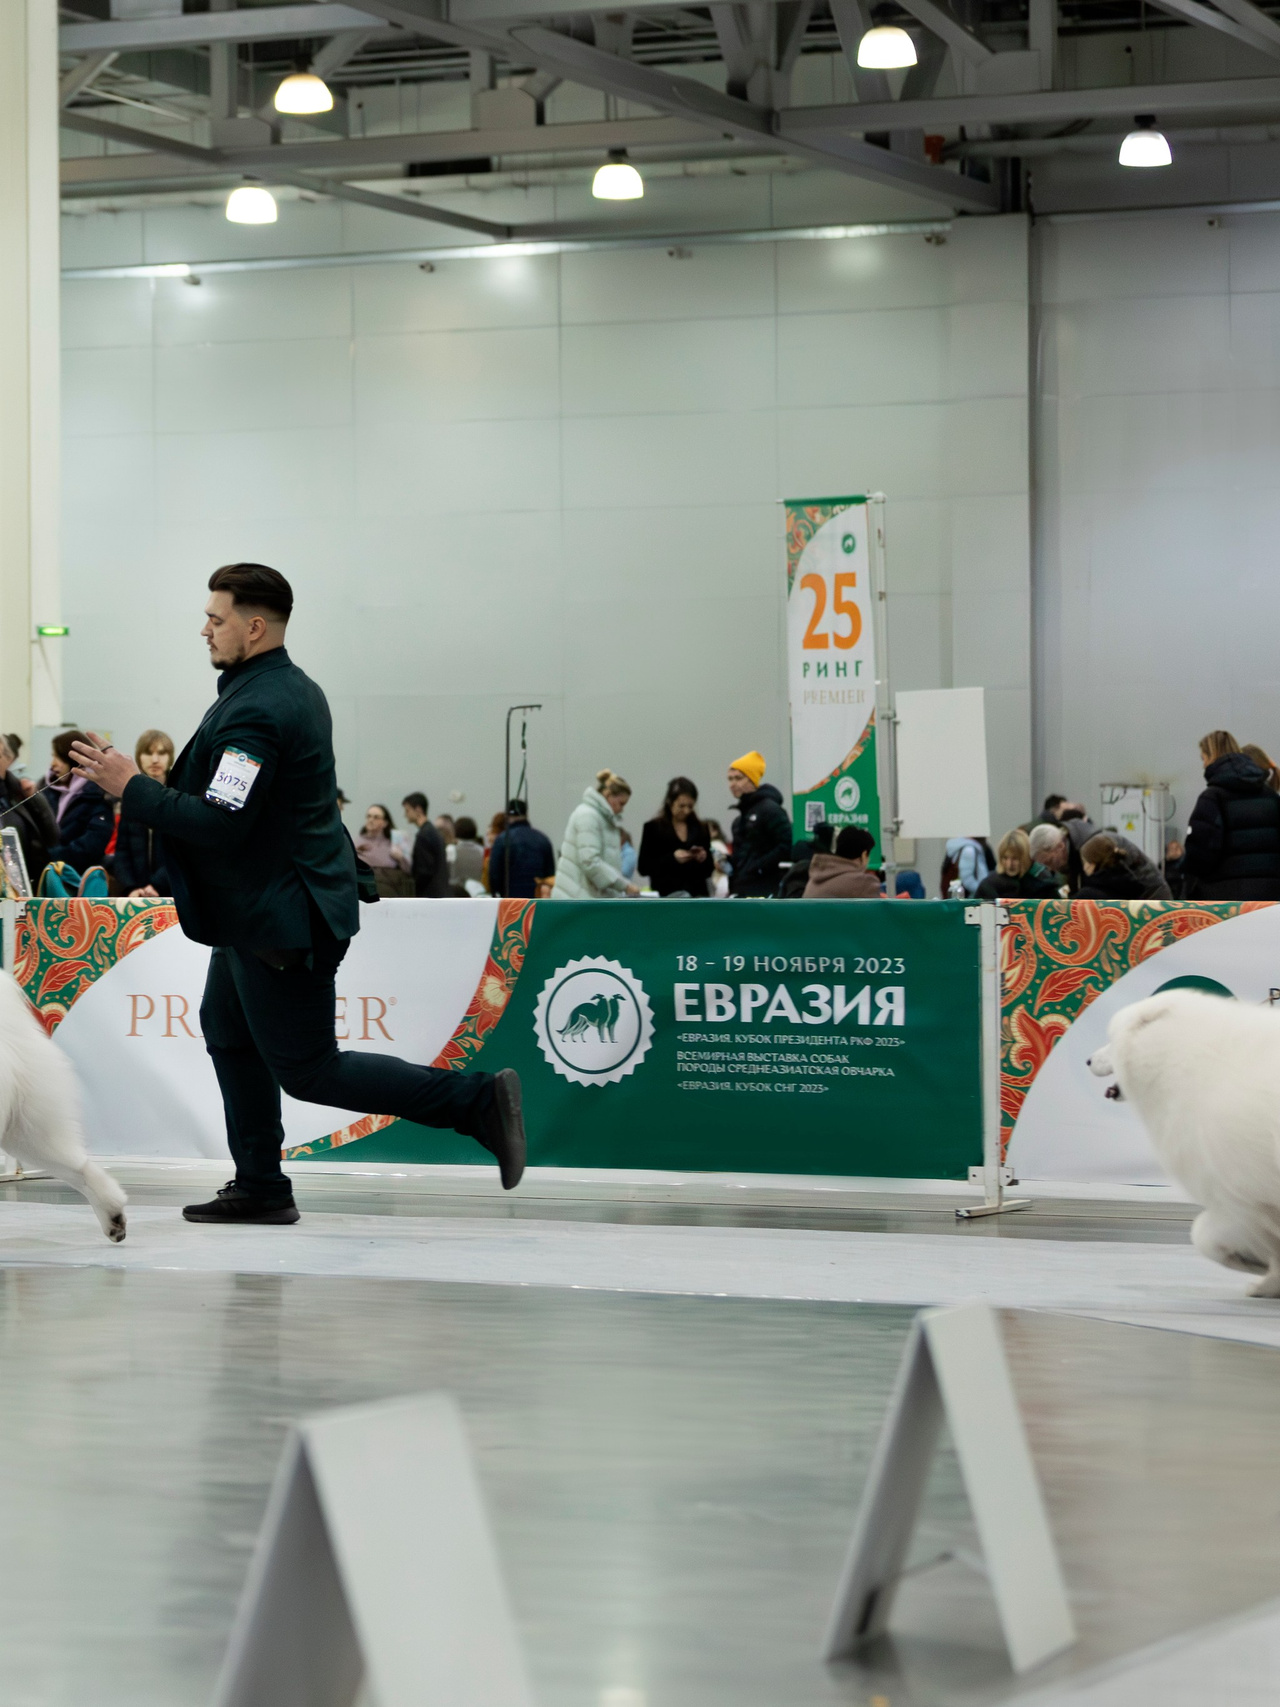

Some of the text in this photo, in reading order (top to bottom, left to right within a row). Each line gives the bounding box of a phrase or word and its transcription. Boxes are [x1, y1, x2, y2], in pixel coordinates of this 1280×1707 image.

[800, 571, 862, 650] 25
[803, 660, 863, 679] РИНГ
[217, 771, 248, 792] 3075
[676, 955, 699, 972] 18
[722, 955, 746, 972] 19
[753, 955, 846, 973] НОЯБРЯ
[853, 957, 906, 974] 2023
[673, 982, 906, 1026] ЕВРАЗИЯ
[734, 1034, 772, 1044] КУБОК
[773, 1035, 849, 1047] ПРЕЗИДЕНТА
[849, 1036, 874, 1047] РКФ
[676, 1051, 850, 1064] ВСЕМИРНАЯ ВЫСТАВКА СОБАК
[676, 1062, 896, 1077] ПОРОДЫ СРЕДНЕАЗИАТСКАЯ ОВЧАРКА
[734, 1082, 773, 1092] КУБОК
[773, 1083, 798, 1093] СНГ
